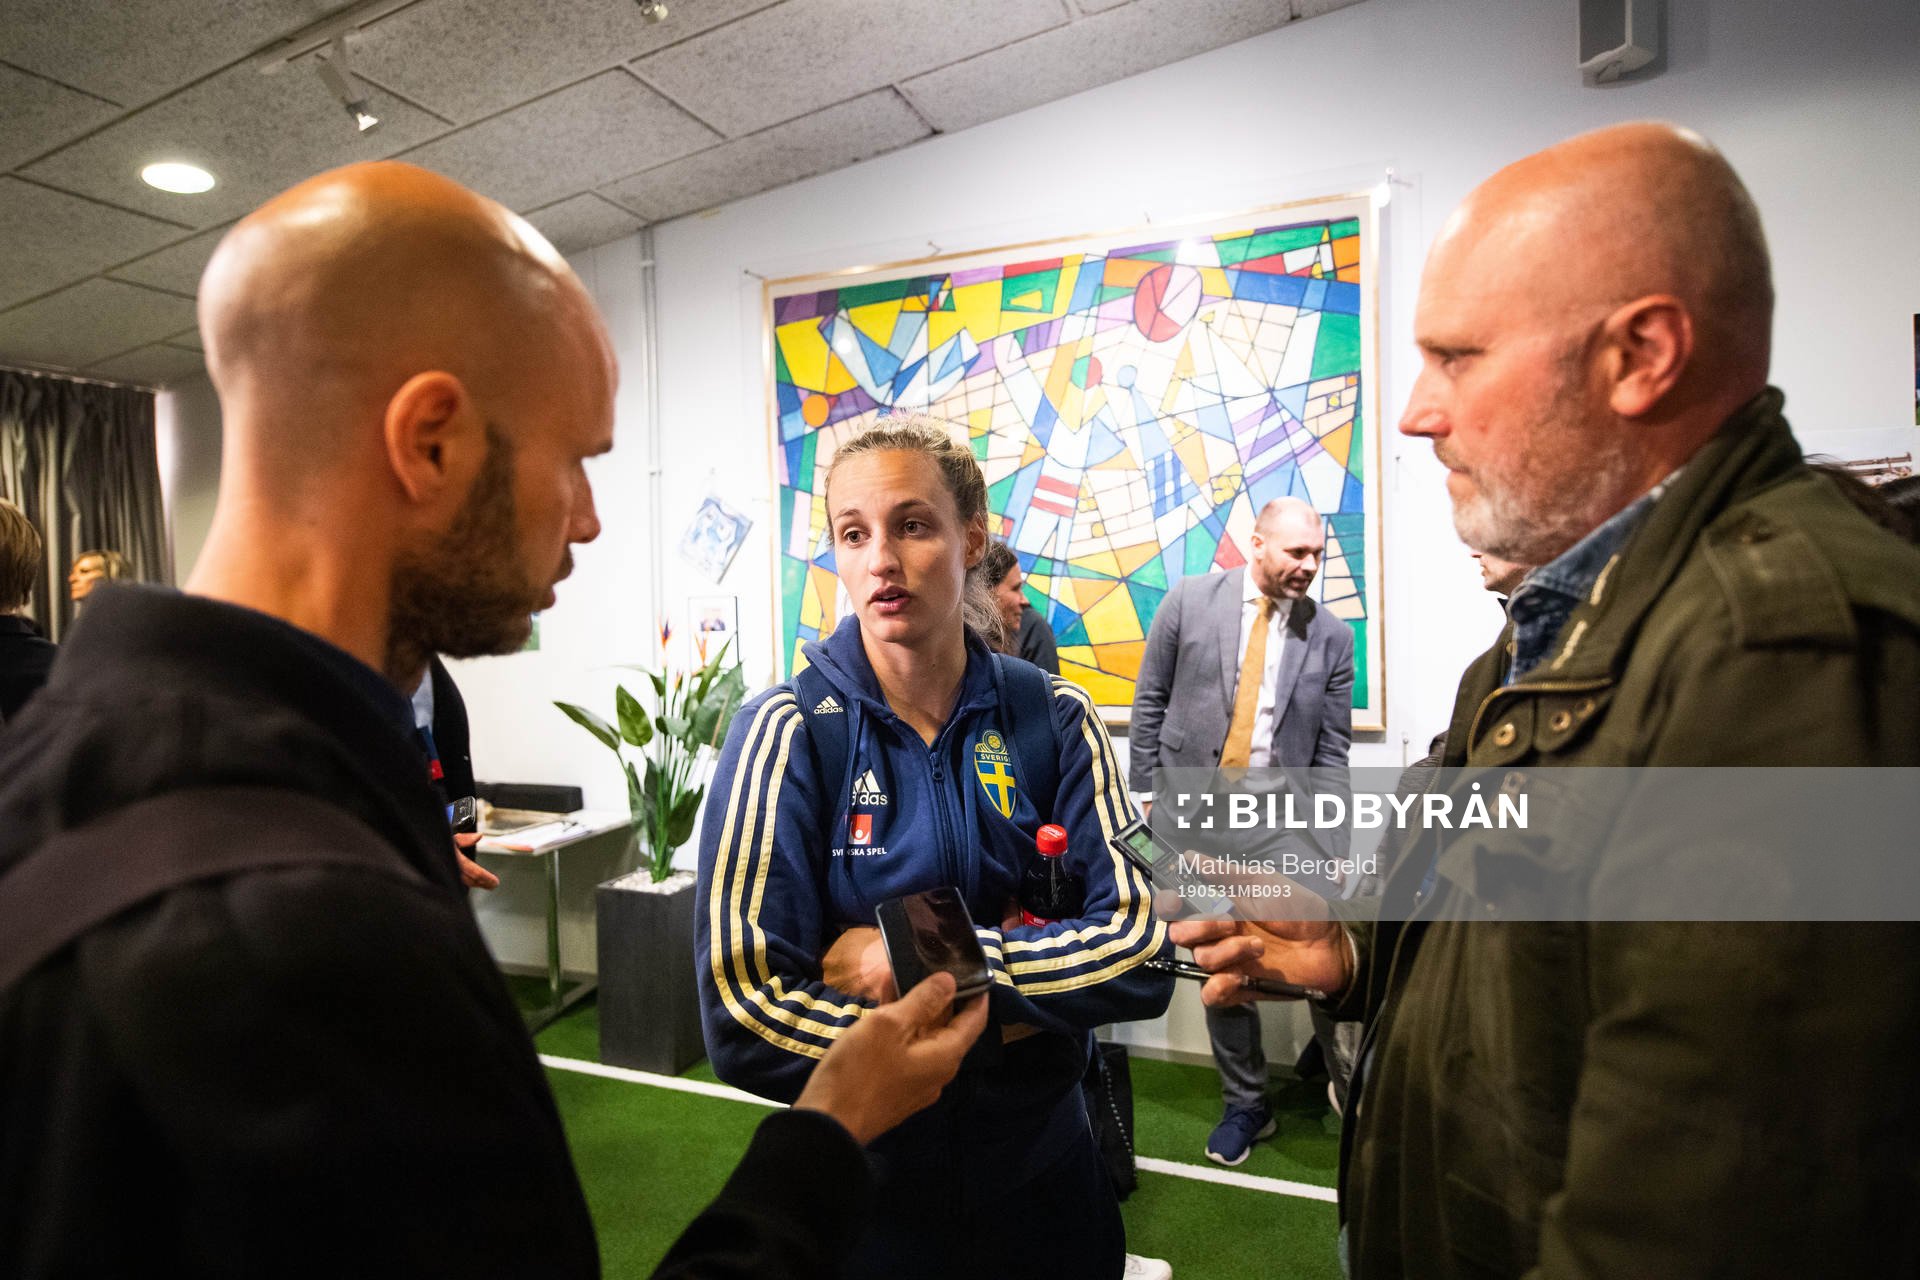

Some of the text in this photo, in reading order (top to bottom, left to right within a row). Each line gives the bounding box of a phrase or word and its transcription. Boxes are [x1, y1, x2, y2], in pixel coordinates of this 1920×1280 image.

[813, 706, 844, 715] adidas
[980, 753, 1010, 762] SVERIG
[866, 846, 888, 856] SPEL
